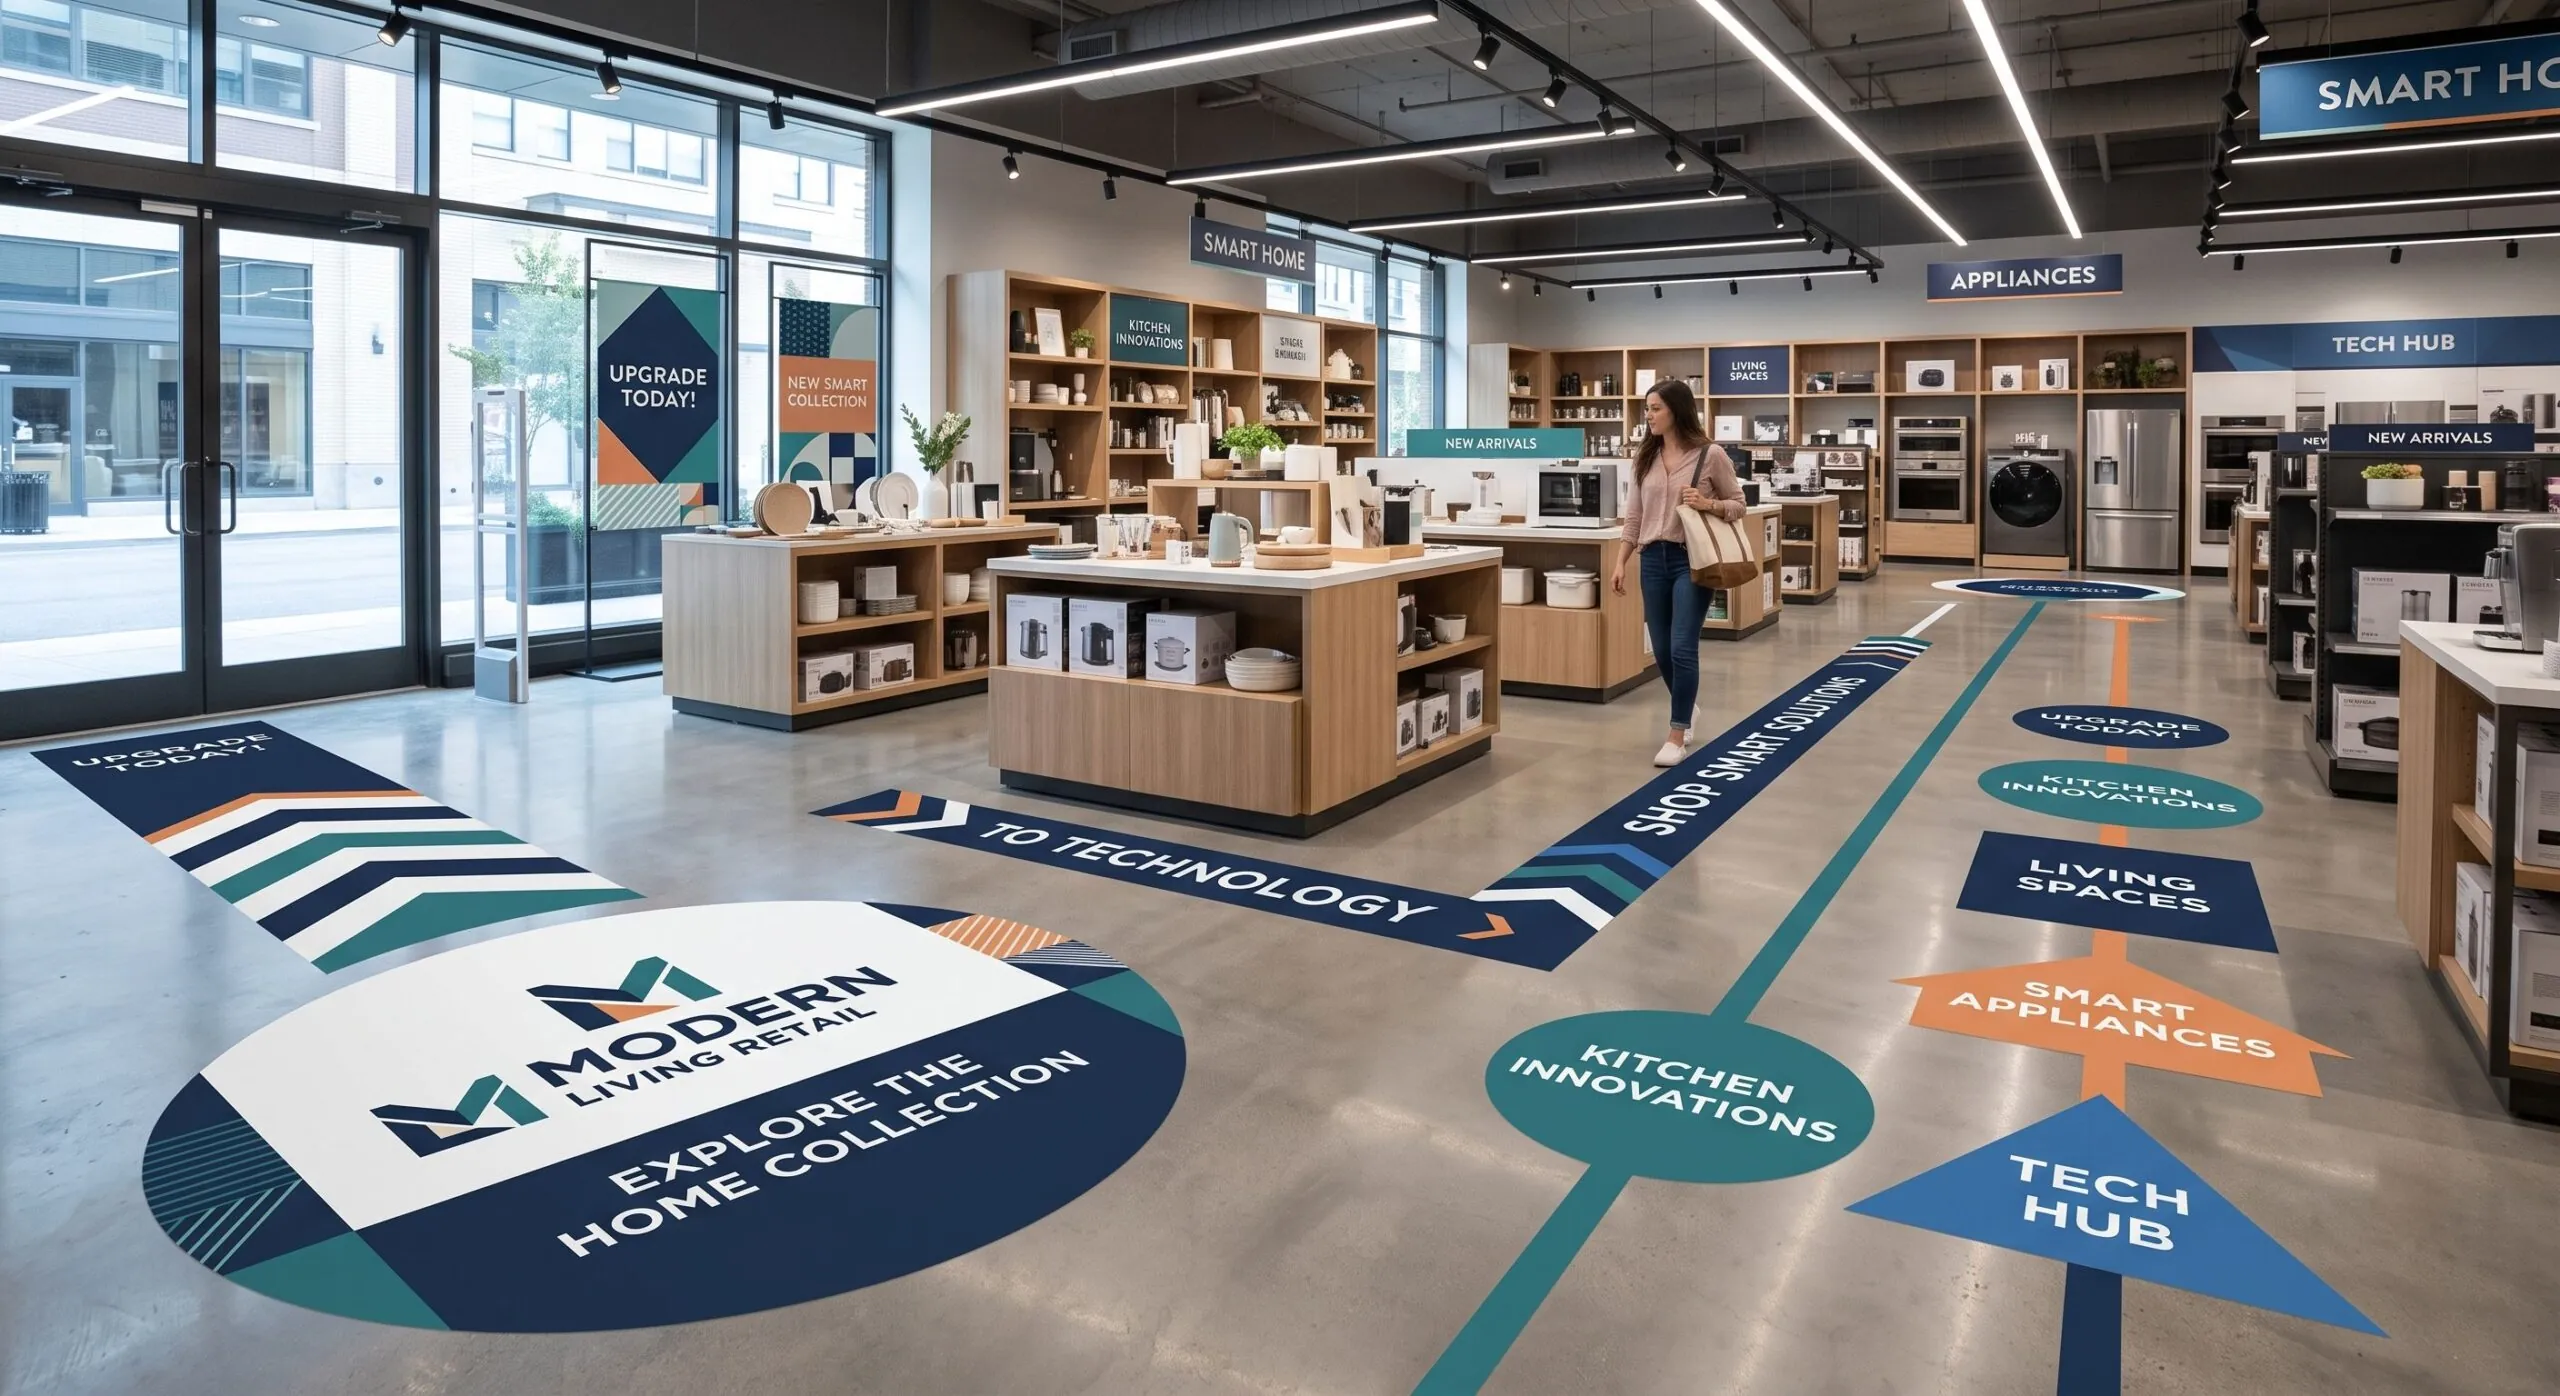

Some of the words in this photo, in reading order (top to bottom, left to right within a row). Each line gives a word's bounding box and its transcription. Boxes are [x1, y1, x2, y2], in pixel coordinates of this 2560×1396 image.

[2318, 65, 2481, 111] SMART
[1204, 232, 1258, 261] SMART
[1262, 243, 1306, 272] HOME
[1951, 265, 2096, 291] APPLIANCES
[1116, 332, 1184, 351] INNOVATIONS
[1129, 319, 1171, 335] KITCHEN
[2332, 335, 2396, 353] TECH
[2403, 334, 2455, 352] HUB
[609, 364, 707, 386] UPGRADE
[1729, 371, 1769, 381] SPACES
[1731, 361, 1767, 371] LIVING
[620, 388, 696, 408] TODAY!
[788, 375, 820, 390] NEW
[824, 376, 868, 391] SMART
[787, 393, 867, 408] COLLECTION
[1446, 437, 1474, 449] NEW
[1476, 437, 1537, 450] ARRIVALS
[2368, 432, 2406, 444] NEW
[2409, 432, 2493, 444] ARRIVALS
[2040, 712, 2201, 732] UPGRADE
[2054, 722, 2181, 739] TODAY!
[72, 733, 273, 767] UPGRADE
[104, 744, 267, 772] TODAY!
[1623, 782, 1722, 836] SHOP
[1696, 731, 1791, 782] SMART
[1763, 676, 1867, 732] SOLUTIONS
[2002, 781, 2238, 813] INNOVATIONS
[2042, 774, 2194, 798] KITCHEN
[979, 822, 1050, 846] TO
[1051, 835, 1439, 923] TECHNOLOGY
[2030, 859, 2196, 892] LIVING
[2016, 876, 2211, 913] SPACES
[2023, 981, 2195, 1020] SMART
[525, 966, 899, 1088] MODERN
[1948, 991, 2276, 1059] APPLIANCES
[566, 1051, 725, 1108] LIVING
[728, 1007, 877, 1056] RETAIL
[1579, 1044, 1795, 1104] KITCHEN
[1508, 1056, 1838, 1143] INNOVATIONS
[608, 1090, 878, 1196] EXPLORE
[872, 1053, 984, 1096] THE
[557, 1171, 760, 1258] HOME
[764, 1050, 1090, 1178] COLLECTION
[2009, 1154, 2190, 1217] TECH
[2024, 1194, 2174, 1251] HUB
